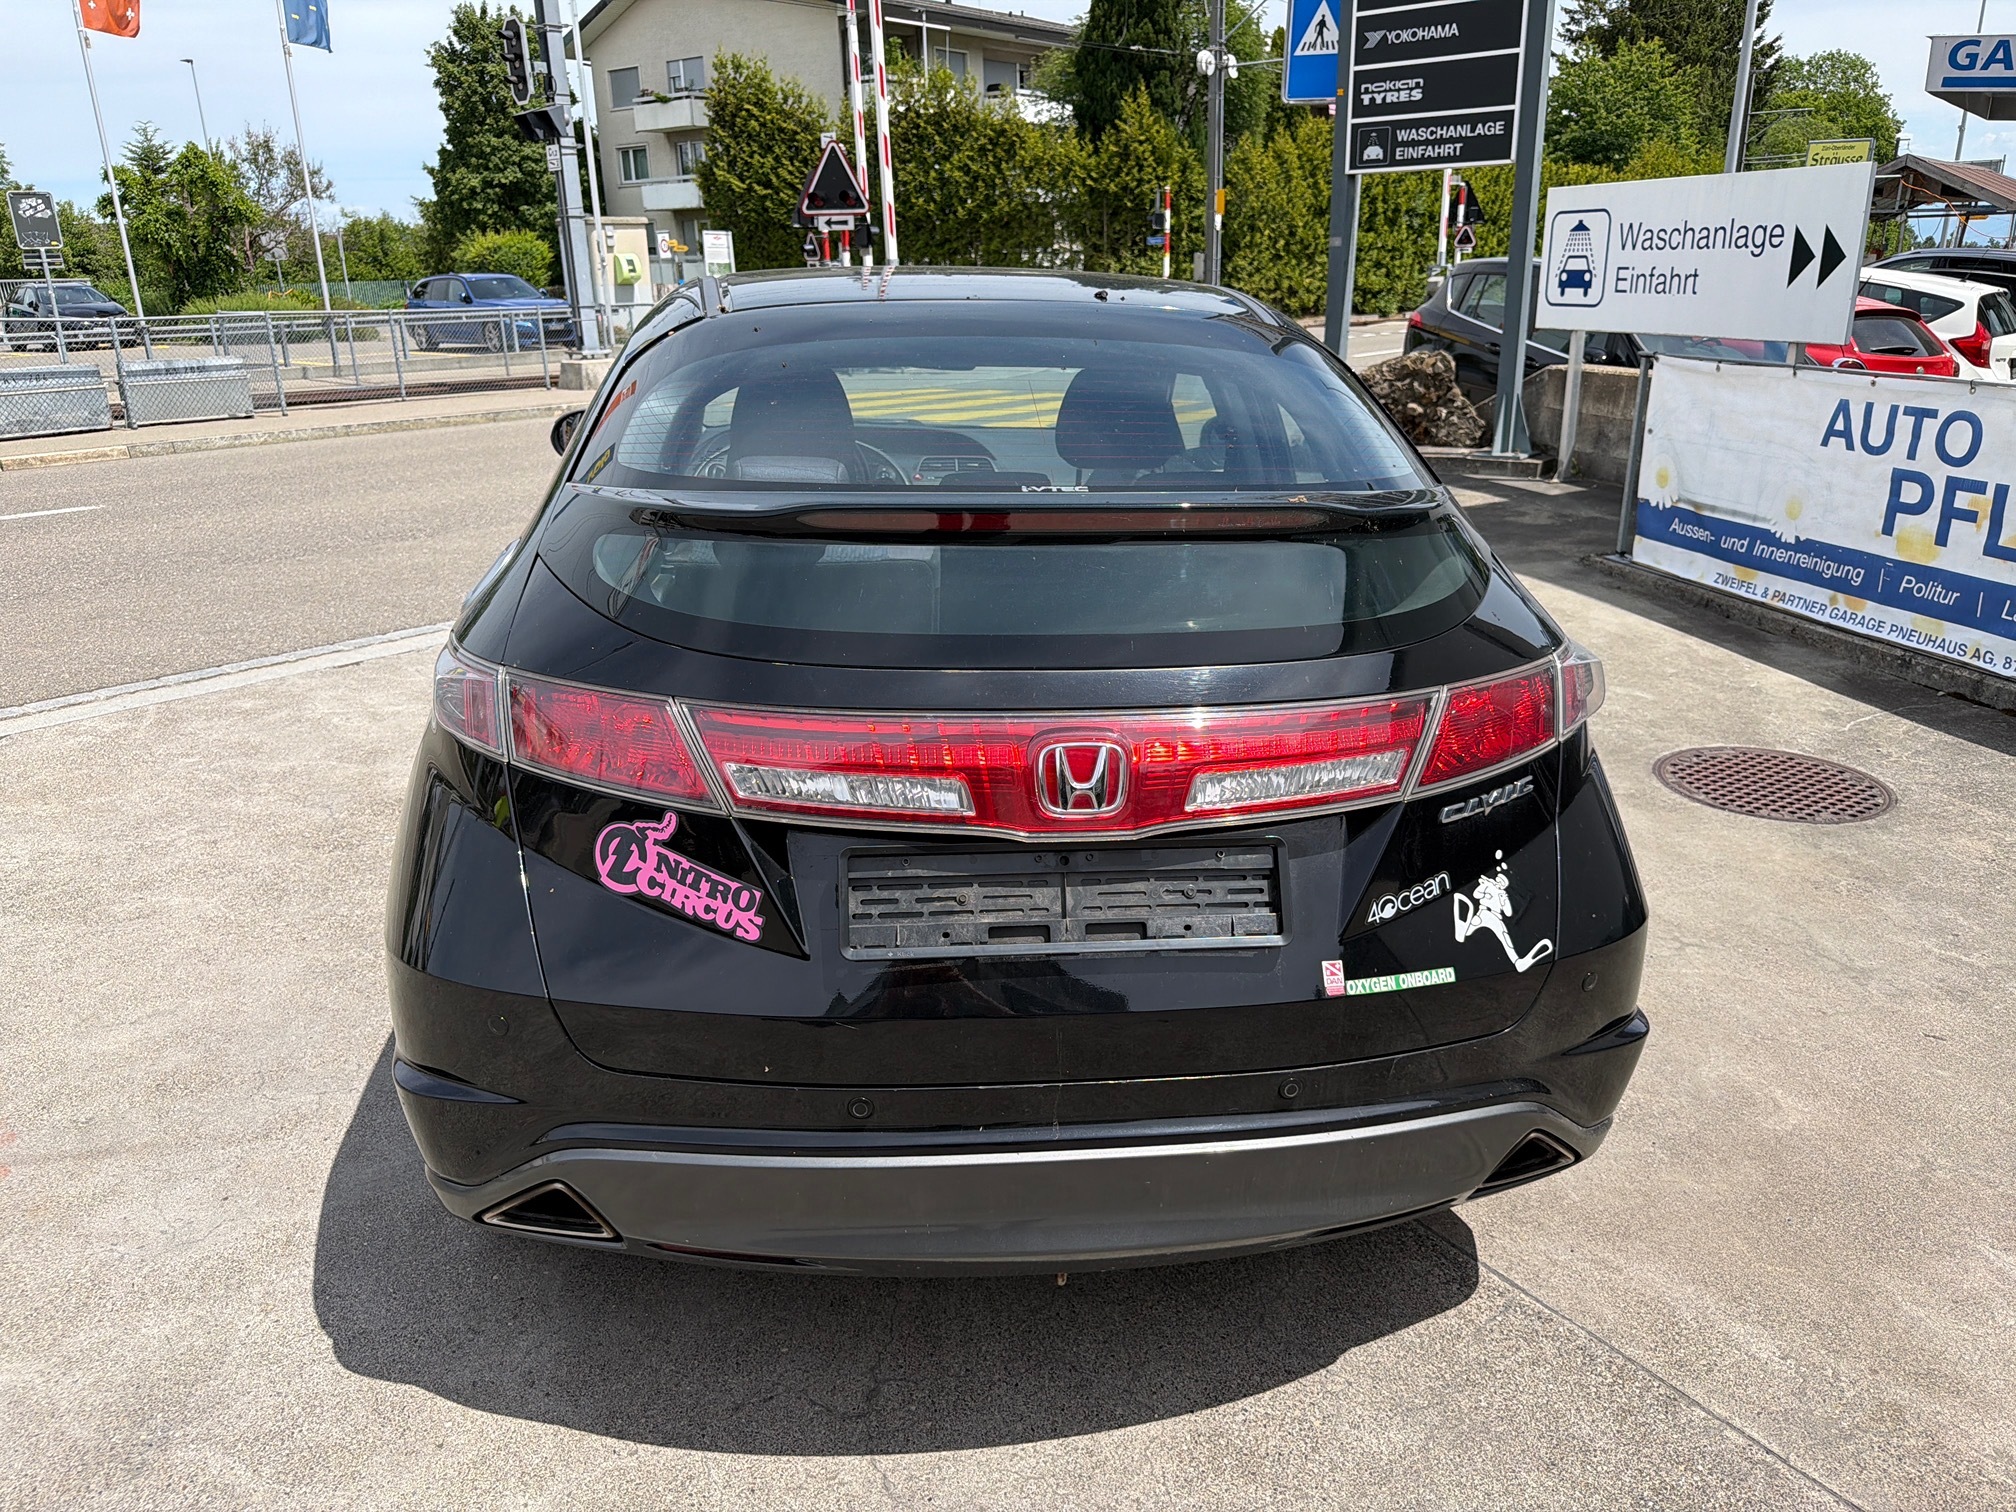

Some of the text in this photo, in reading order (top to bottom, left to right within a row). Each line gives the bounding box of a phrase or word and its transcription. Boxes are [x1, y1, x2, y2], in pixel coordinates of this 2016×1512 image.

[1386, 23, 1459, 44] YOKOHAMA
[1948, 38, 2014, 71] GA
[1360, 88, 1423, 105] TYRES
[1396, 121, 1505, 142] WASCHANLAGE
[1395, 143, 1463, 160] EINFAHRT
[1620, 218, 1785, 257] Waschanlage
[1614, 266, 1699, 295] Einfahrt
[1820, 398, 1983, 468] AUTO
[1881, 467, 2016, 563] PFL
[1669, 517, 1715, 543] Aussen-
[1720, 536, 1749, 553] und
[1752, 539, 1865, 586] Innenreinigung
[1899, 575, 1960, 605] Politur
[1713, 572, 1758, 596] ZWEIFEL
[1761, 586, 1769, 599] &
[1771, 590, 1828, 617] PARTNER
[1829, 607, 1886, 633] GARAGE
[1887, 624, 1968, 657] PNEUHAUS
[1969, 647, 1997, 668] AG,
[654, 851, 758, 913] NITRO
[636, 867, 764, 941] CIRCUS
[1326, 977, 1343, 985] DAN
[1346, 976, 1397, 995] OXYGEN
[1400, 968, 1455, 988] ONBOARD
